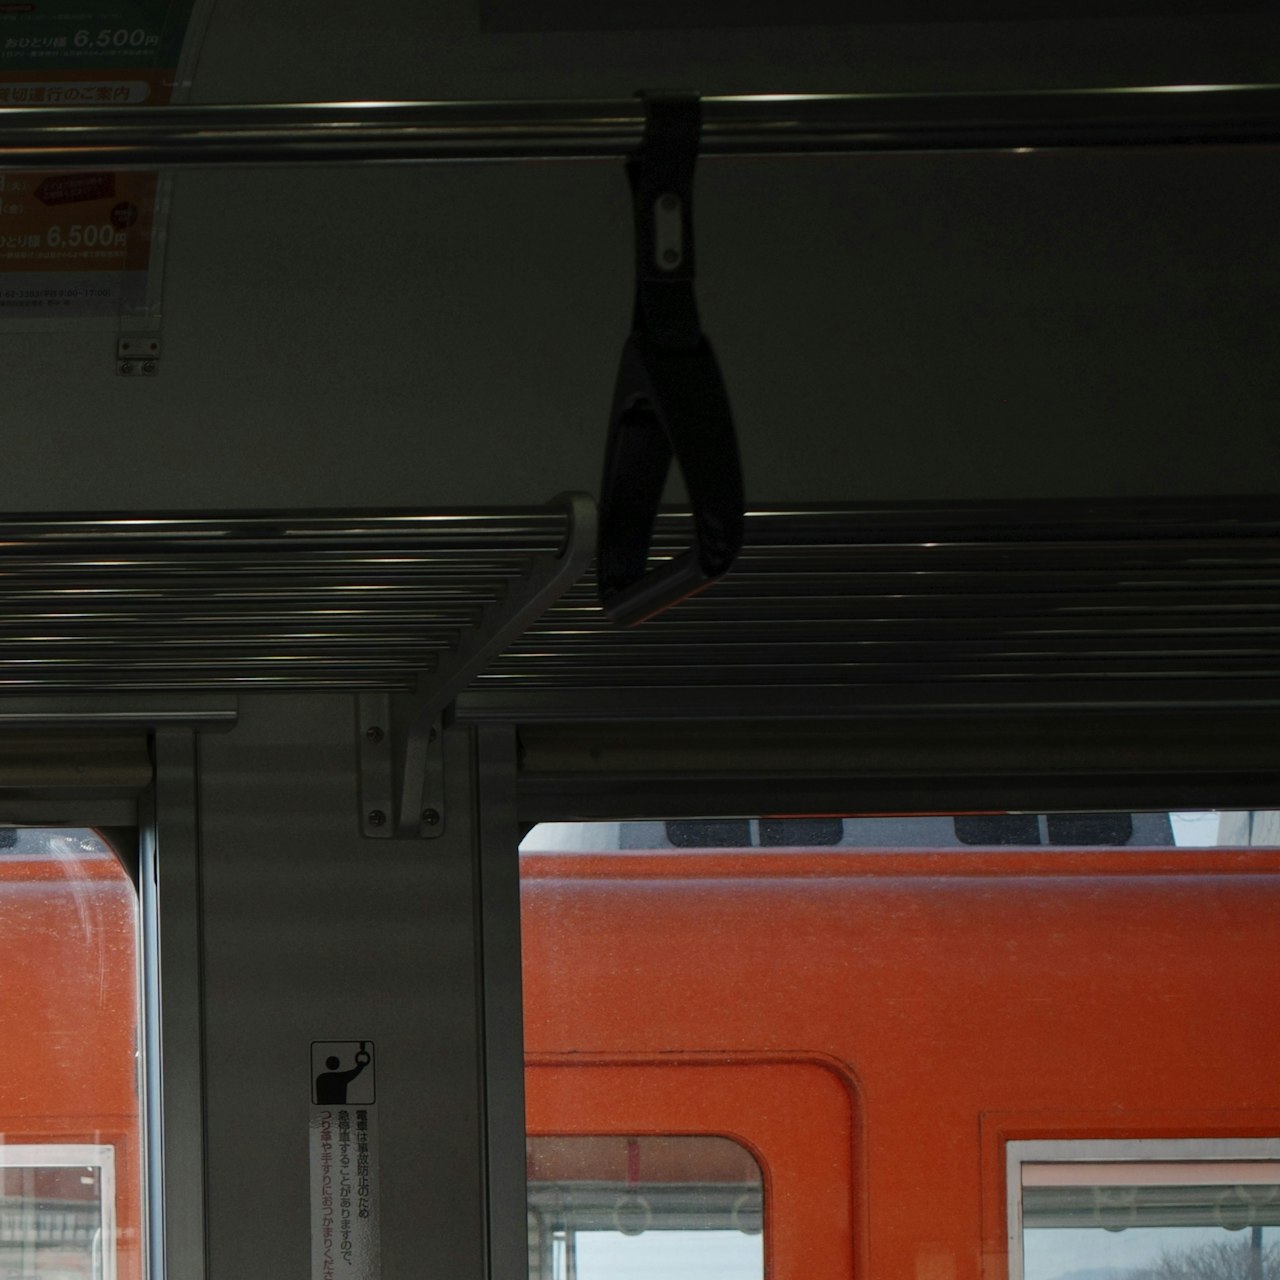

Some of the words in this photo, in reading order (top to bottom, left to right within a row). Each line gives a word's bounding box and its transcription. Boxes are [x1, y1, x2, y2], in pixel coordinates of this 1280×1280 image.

[4, 36, 68, 48] おひとり様
[73, 29, 159, 49] 6,500円
[47, 223, 127, 249] 6,500円
[337, 1109, 352, 1266] 急停車することがありますので、
[356, 1109, 370, 1219] 電車は事故防止のため
